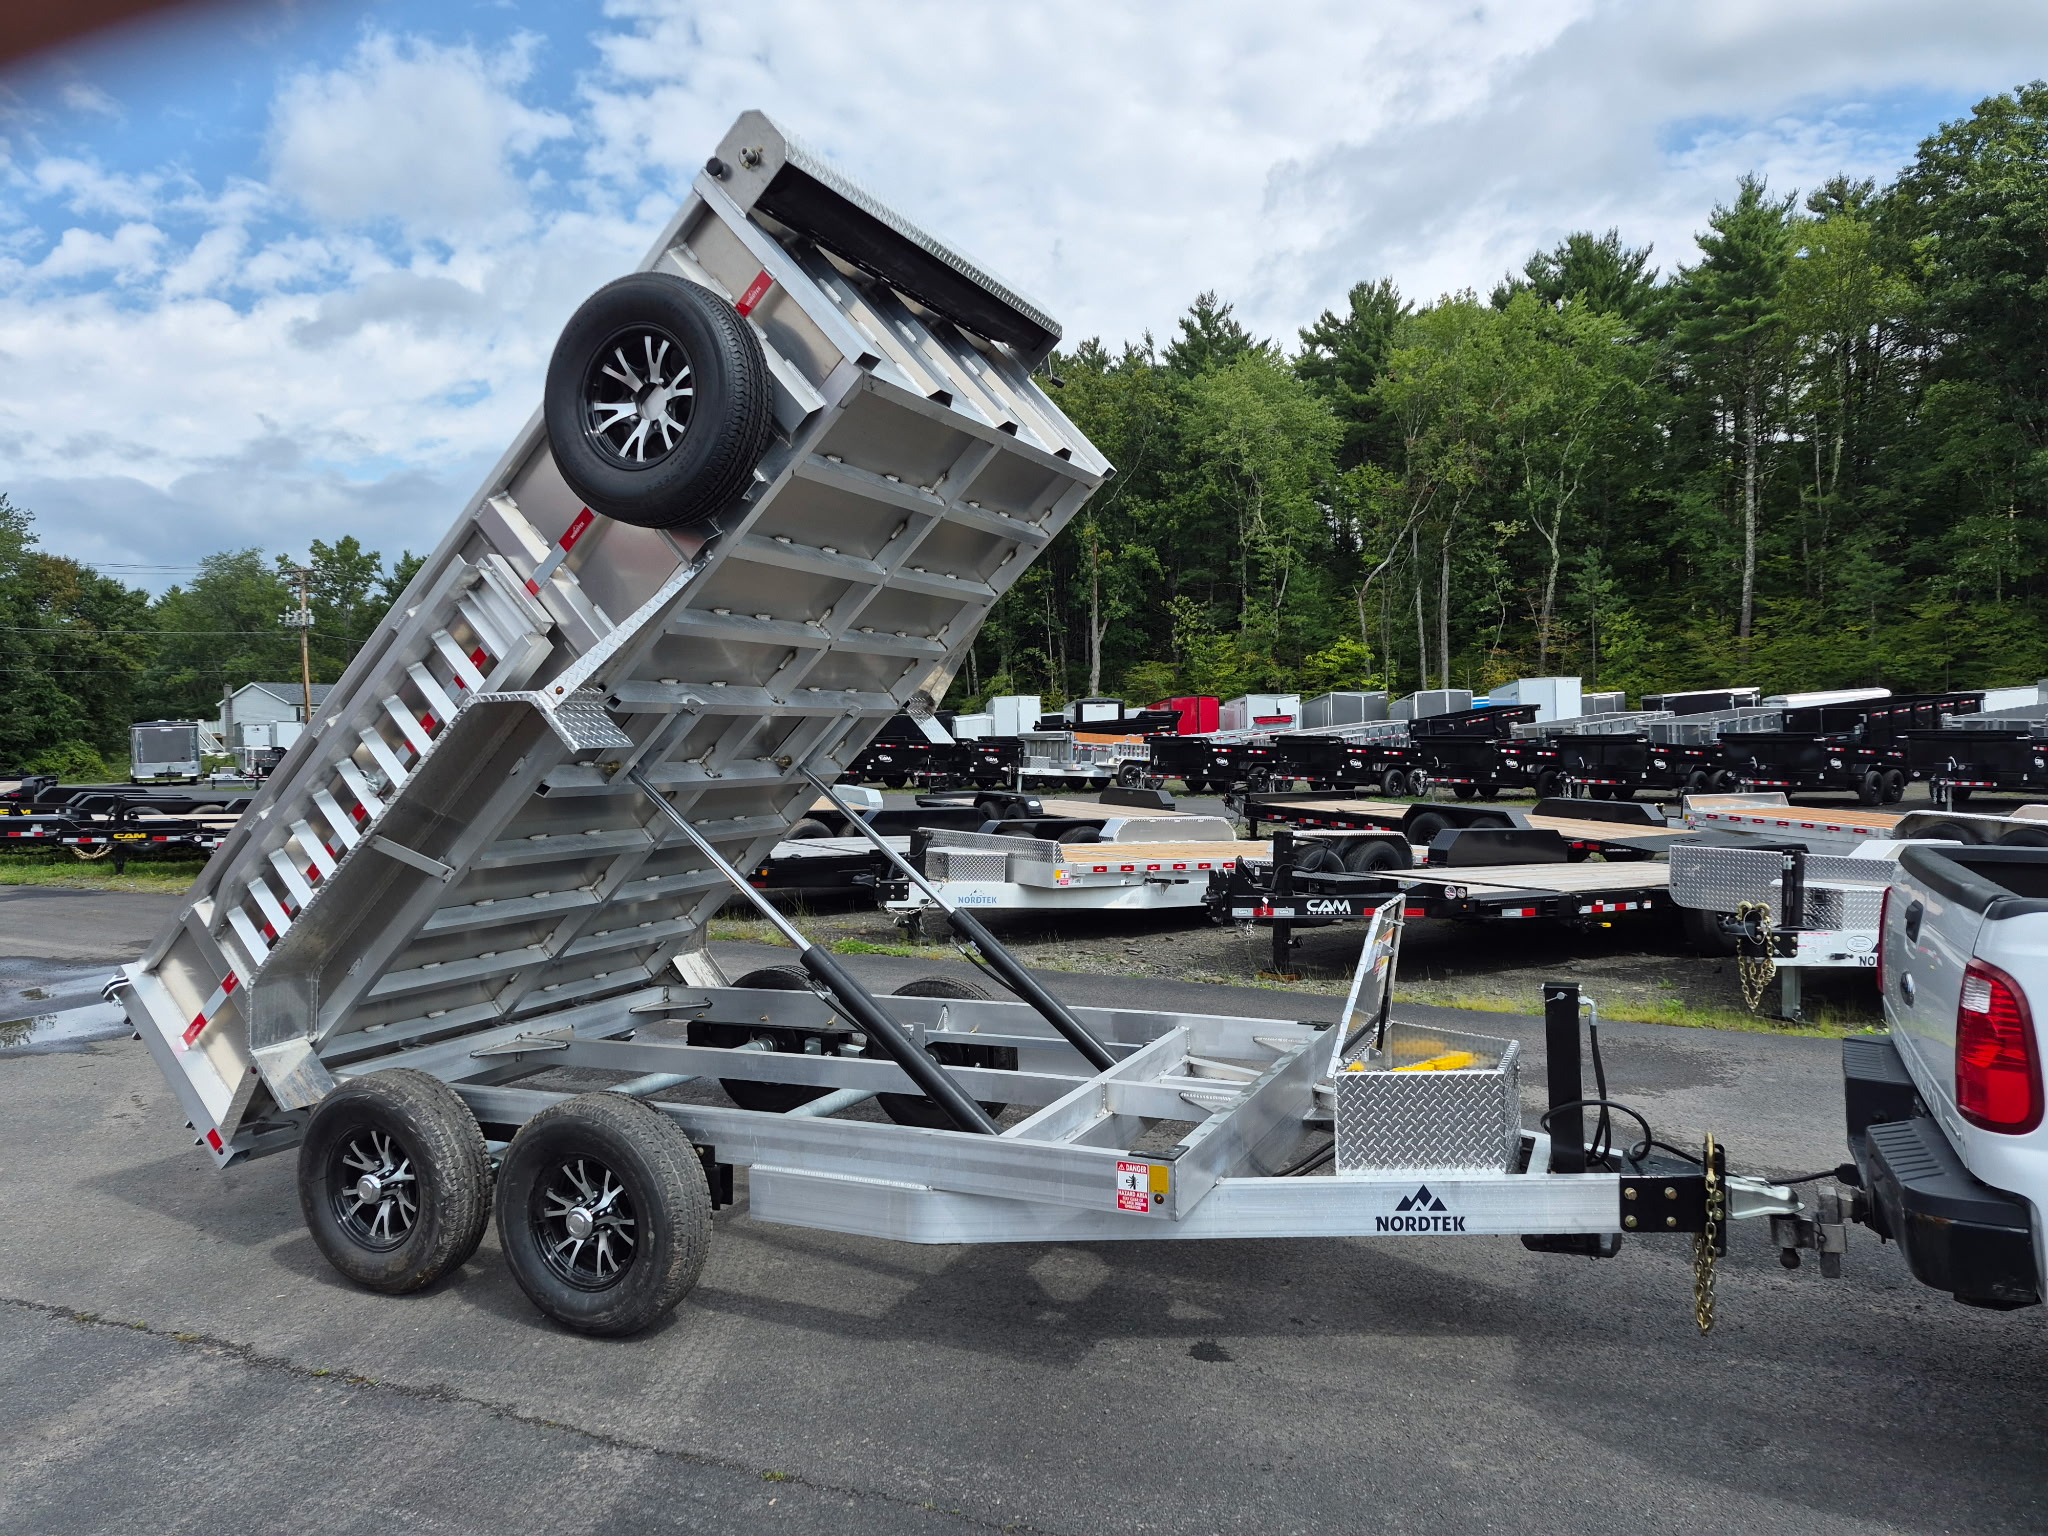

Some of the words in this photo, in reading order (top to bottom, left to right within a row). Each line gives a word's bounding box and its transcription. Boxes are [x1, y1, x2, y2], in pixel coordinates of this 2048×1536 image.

[957, 896, 997, 904] NORDTEK
[1306, 899, 1351, 912] CAM
[1859, 956, 1878, 967] NO
[1125, 1163, 1147, 1174] DANGER
[1375, 1216, 1466, 1232] NORDTEK
